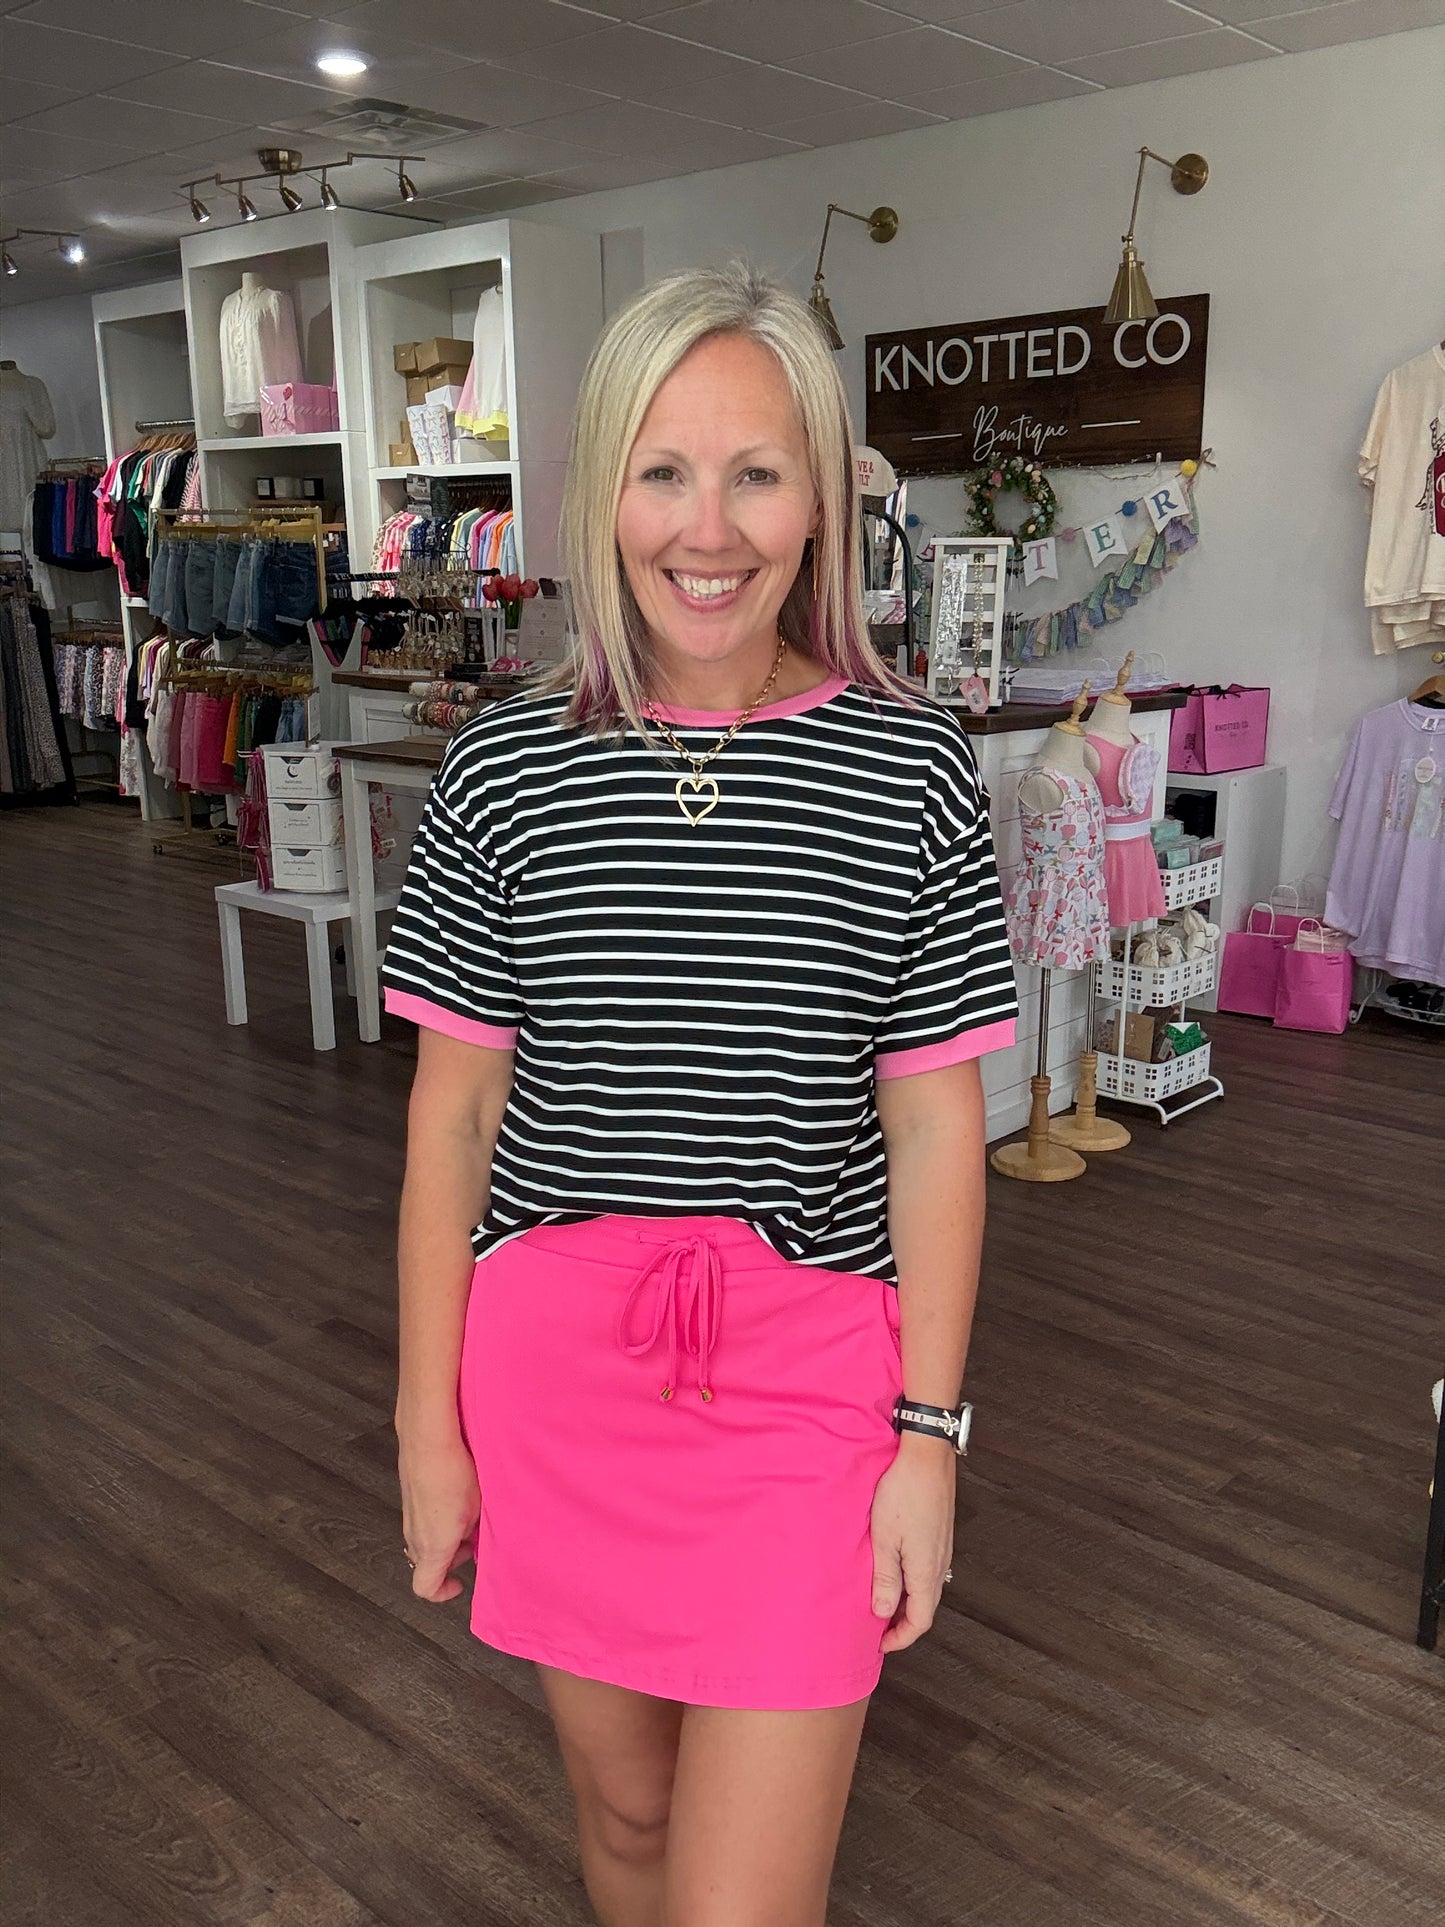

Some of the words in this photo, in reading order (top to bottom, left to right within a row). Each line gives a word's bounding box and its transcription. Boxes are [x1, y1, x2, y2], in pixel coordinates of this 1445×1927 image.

[874, 325, 1092, 393] KNOTTED
[1112, 312, 1192, 369] CO
[972, 404, 1069, 462] Boutique
